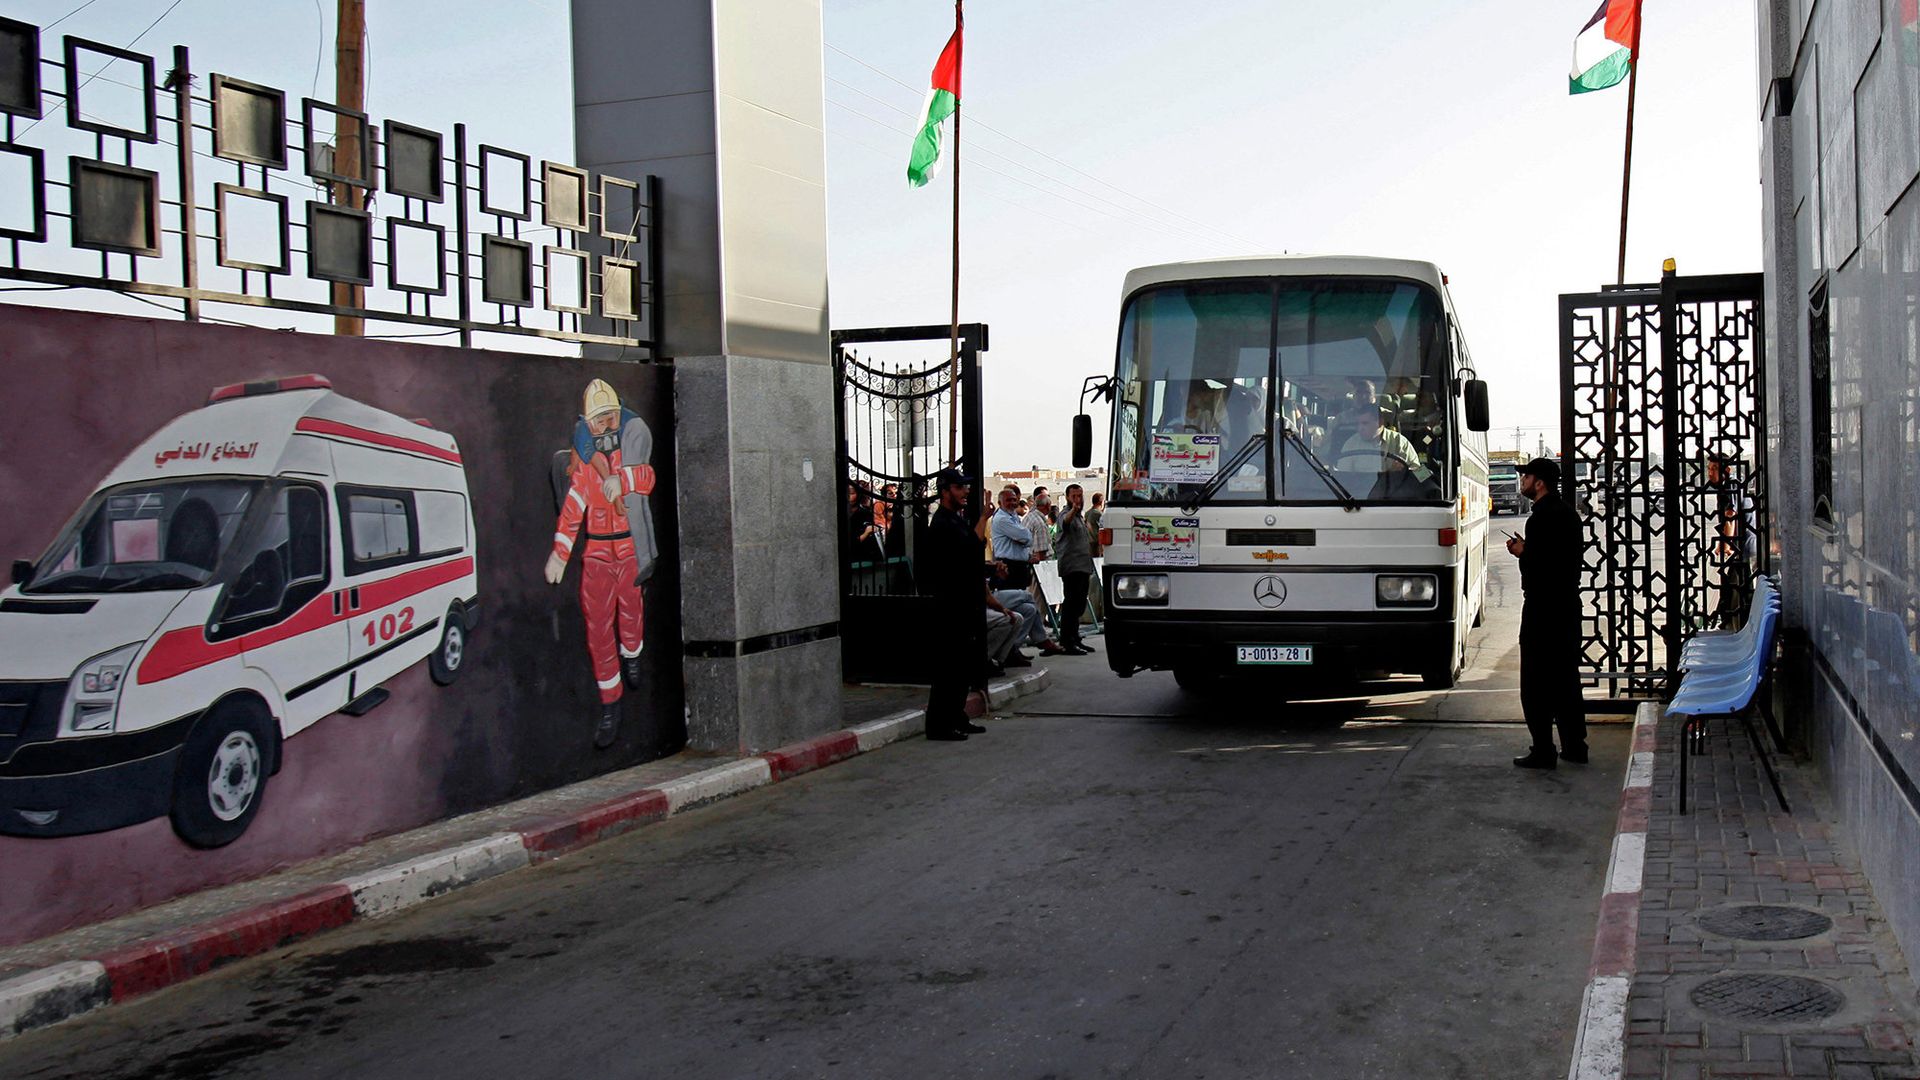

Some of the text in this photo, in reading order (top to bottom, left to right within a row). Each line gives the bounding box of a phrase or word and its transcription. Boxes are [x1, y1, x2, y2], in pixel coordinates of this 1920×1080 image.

[155, 440, 259, 469] الدفاع المدني
[1175, 519, 1197, 527] شركة
[362, 606, 415, 646] 102
